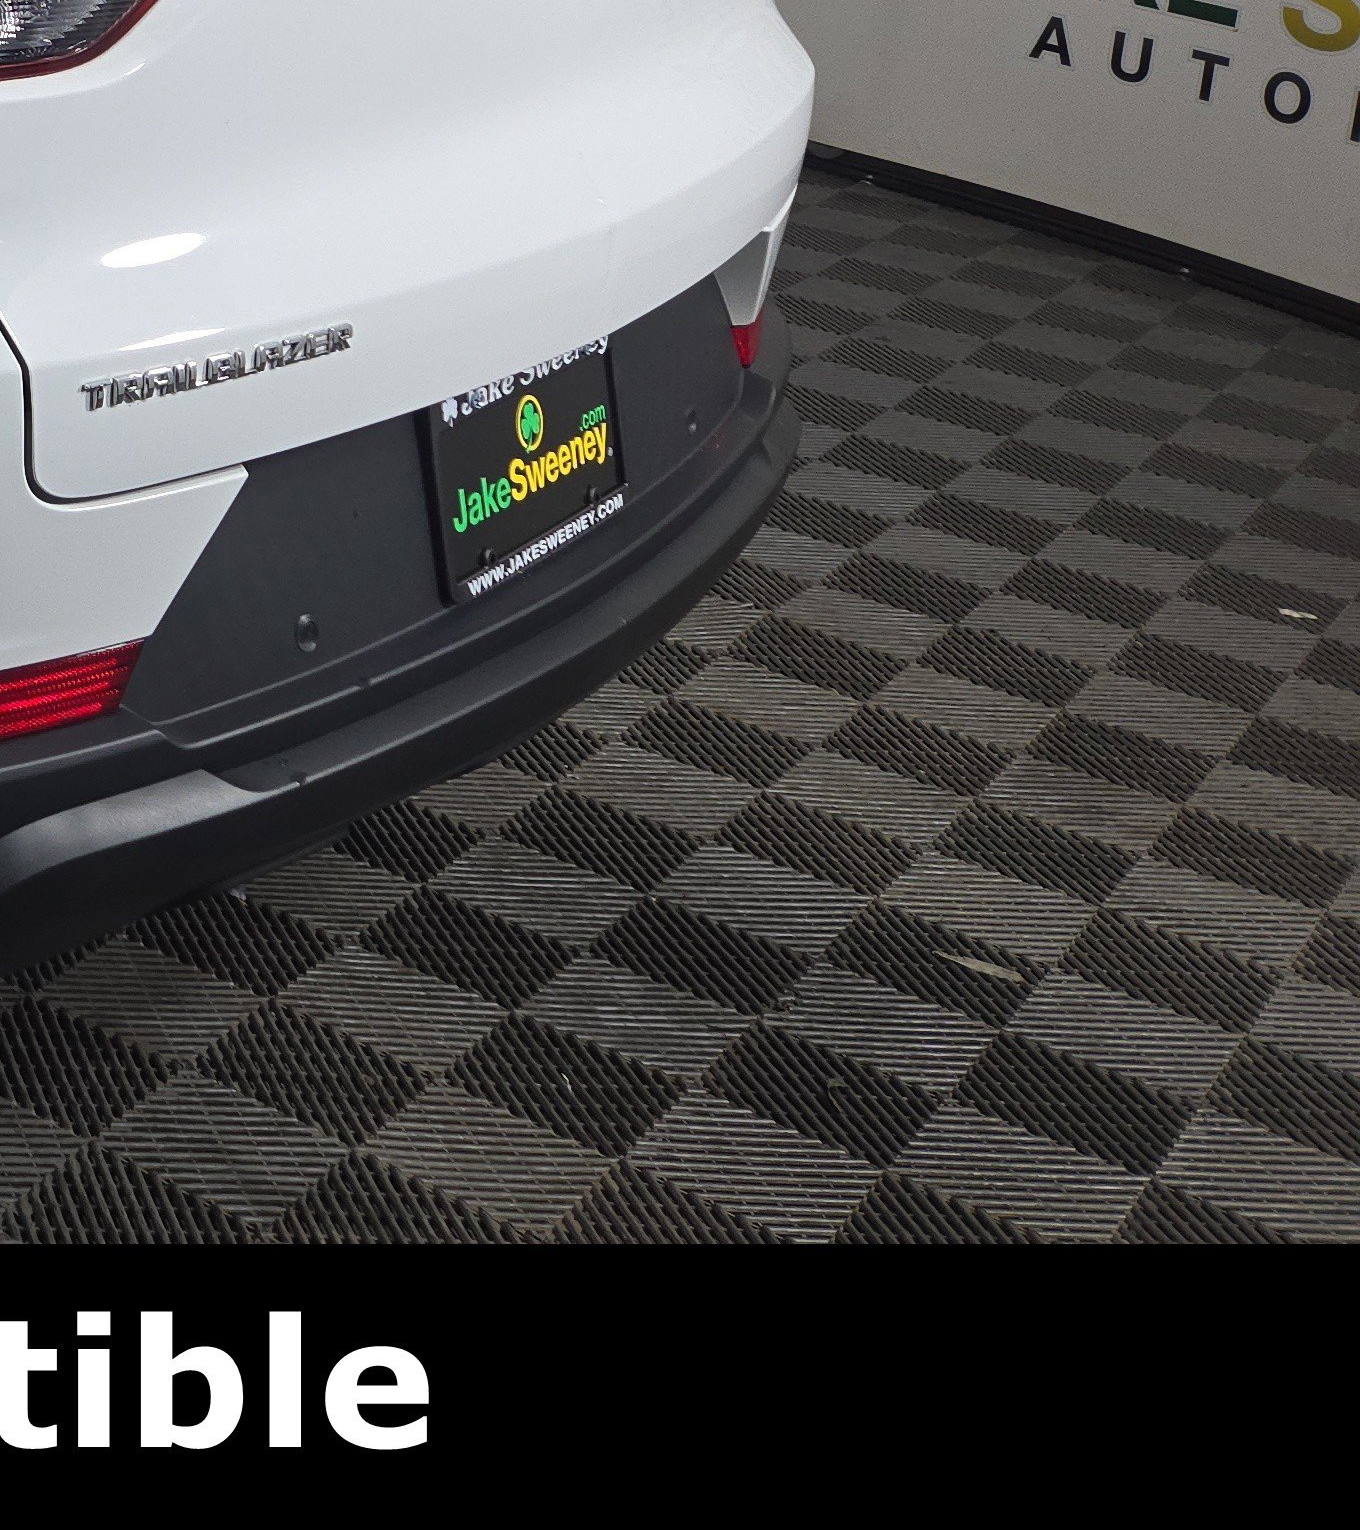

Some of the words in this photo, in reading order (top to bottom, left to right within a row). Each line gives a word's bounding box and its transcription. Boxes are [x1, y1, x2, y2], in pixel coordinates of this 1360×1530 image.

[1028, 16, 1360, 143] AUTO
[78, 323, 354, 411] TRAILBLAZER
[461, 374, 515, 415] Jake
[579, 404, 607, 431] .com
[452, 423, 607, 533] JakeSweeney
[467, 493, 624, 597] WWW.JAKESWEENEY.COM
